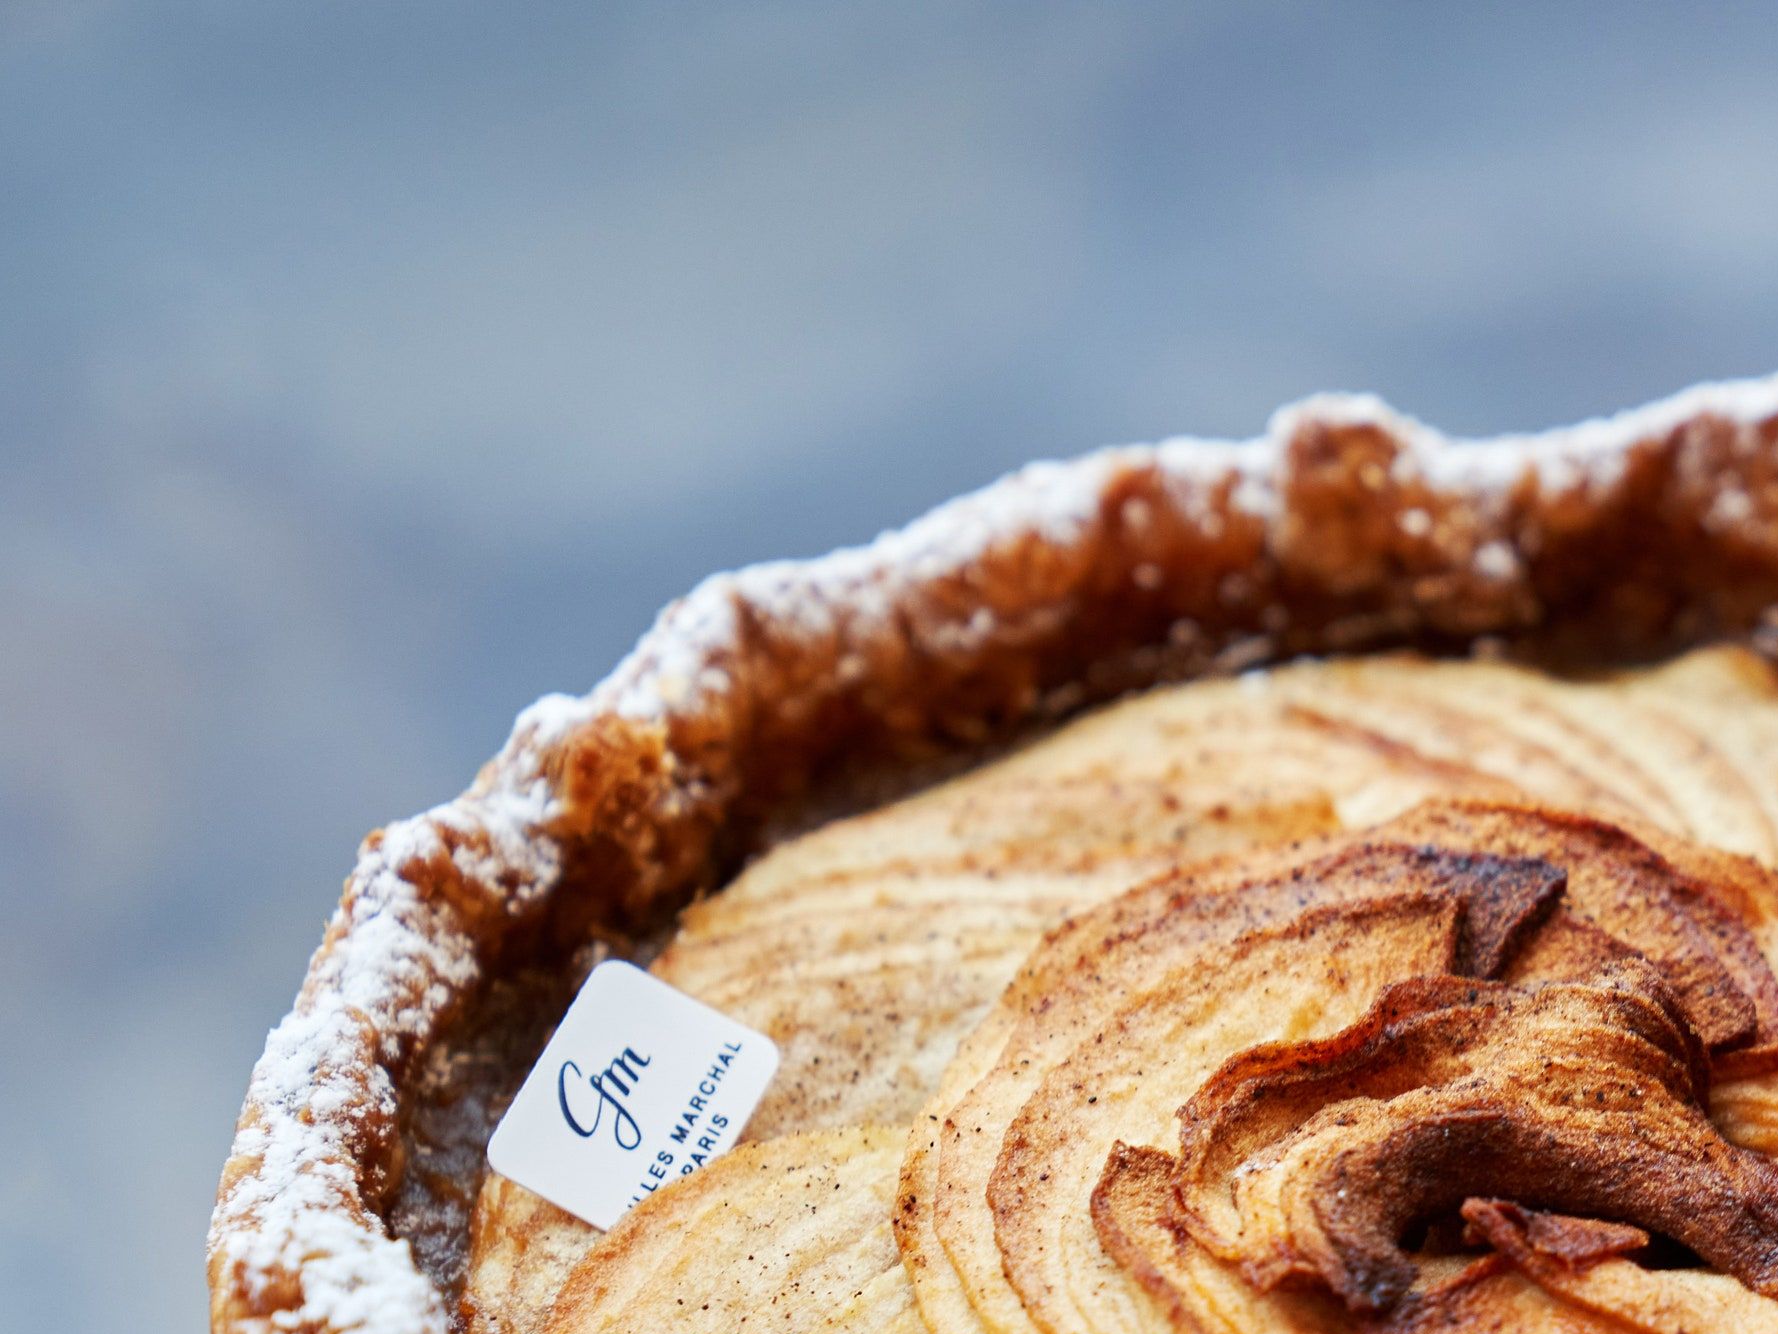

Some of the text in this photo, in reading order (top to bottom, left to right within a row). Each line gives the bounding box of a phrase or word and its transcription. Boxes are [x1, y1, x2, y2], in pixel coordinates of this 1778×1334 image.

[627, 1042, 742, 1209] LES MARCHAL
[680, 1114, 729, 1176] PARIS
